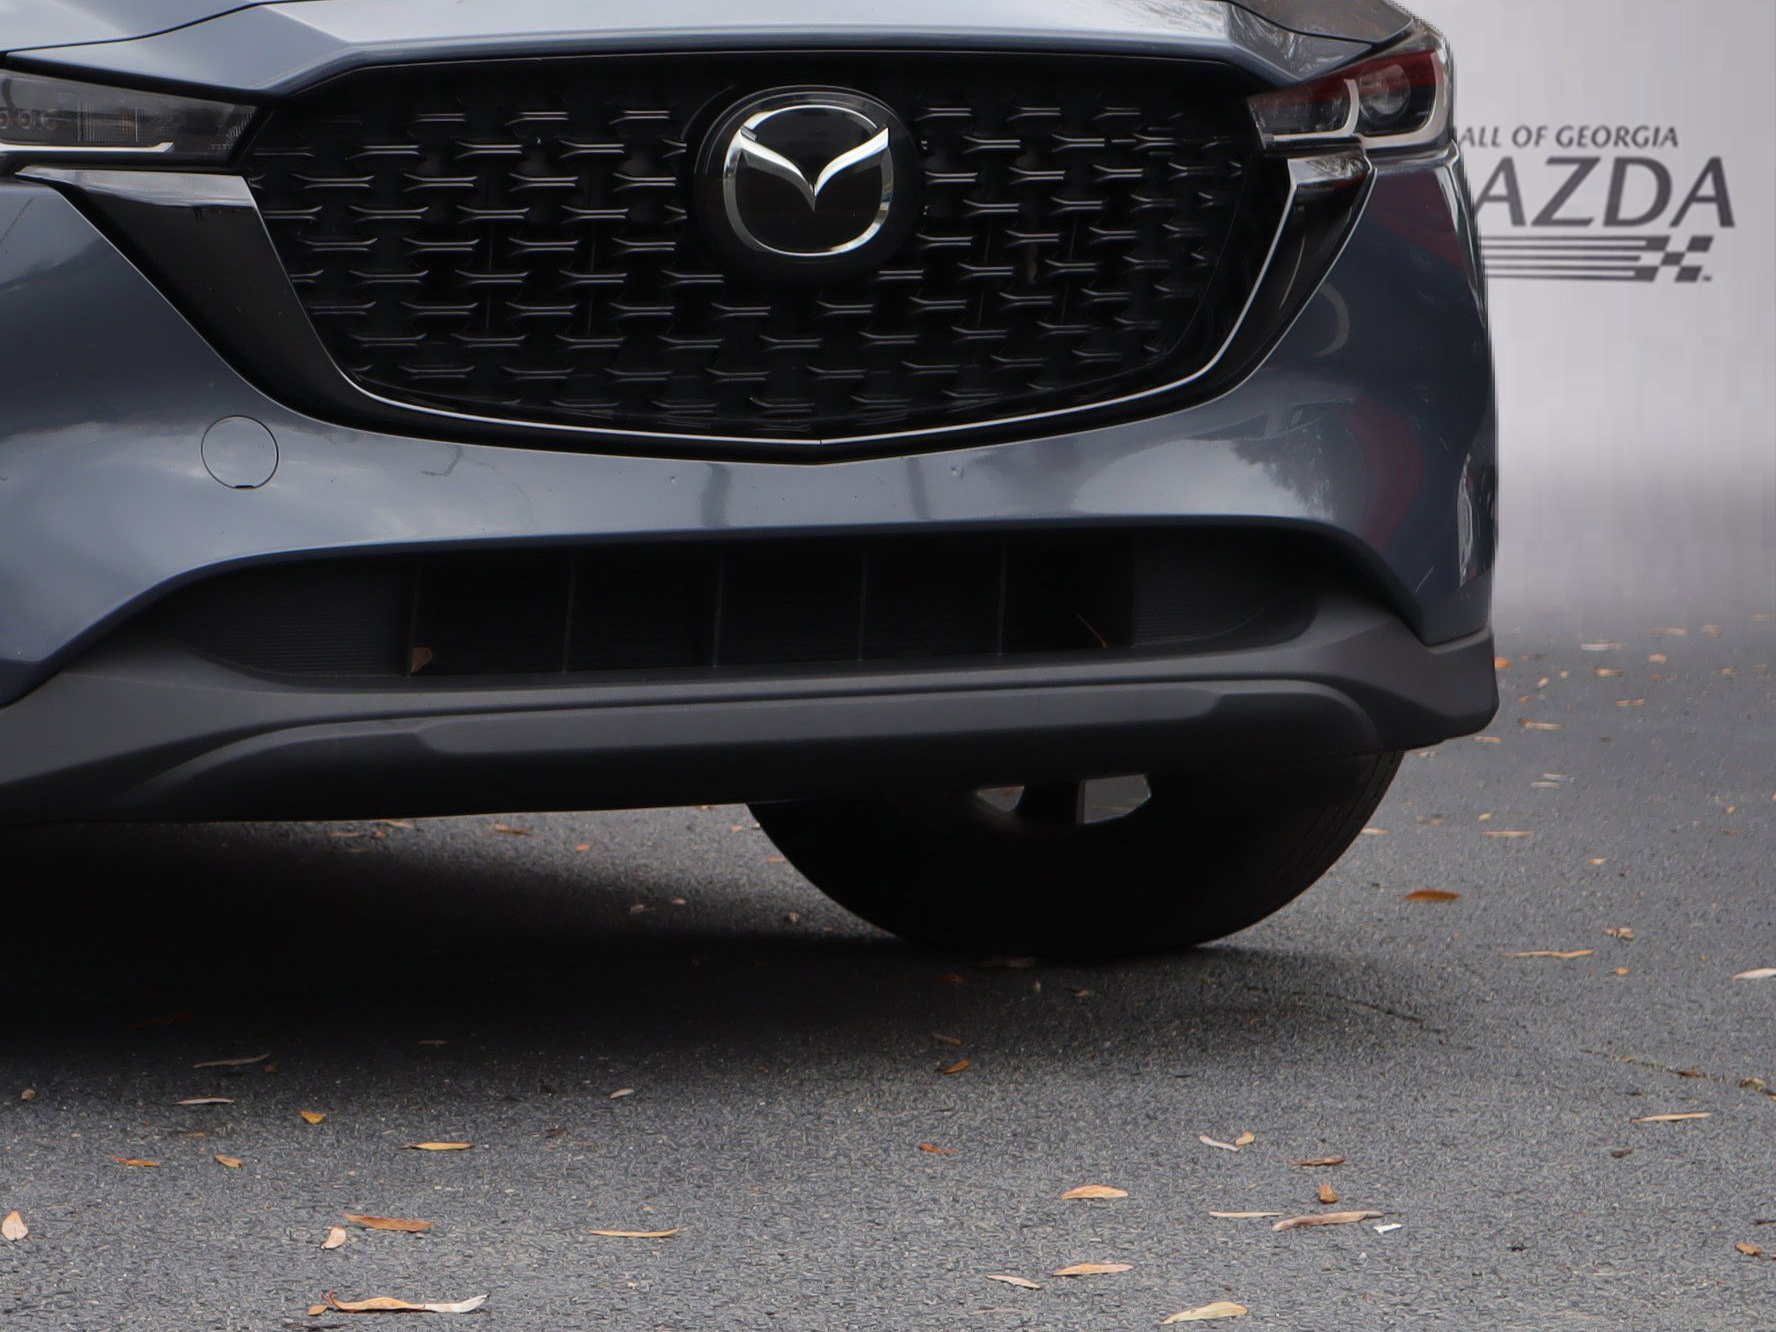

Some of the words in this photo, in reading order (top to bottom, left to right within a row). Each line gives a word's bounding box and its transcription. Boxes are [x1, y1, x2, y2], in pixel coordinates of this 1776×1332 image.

[1458, 126, 1502, 148] ALL
[1511, 125, 1547, 148] OF
[1554, 125, 1679, 148] GEORGIA
[1471, 156, 1736, 228] AZDA
